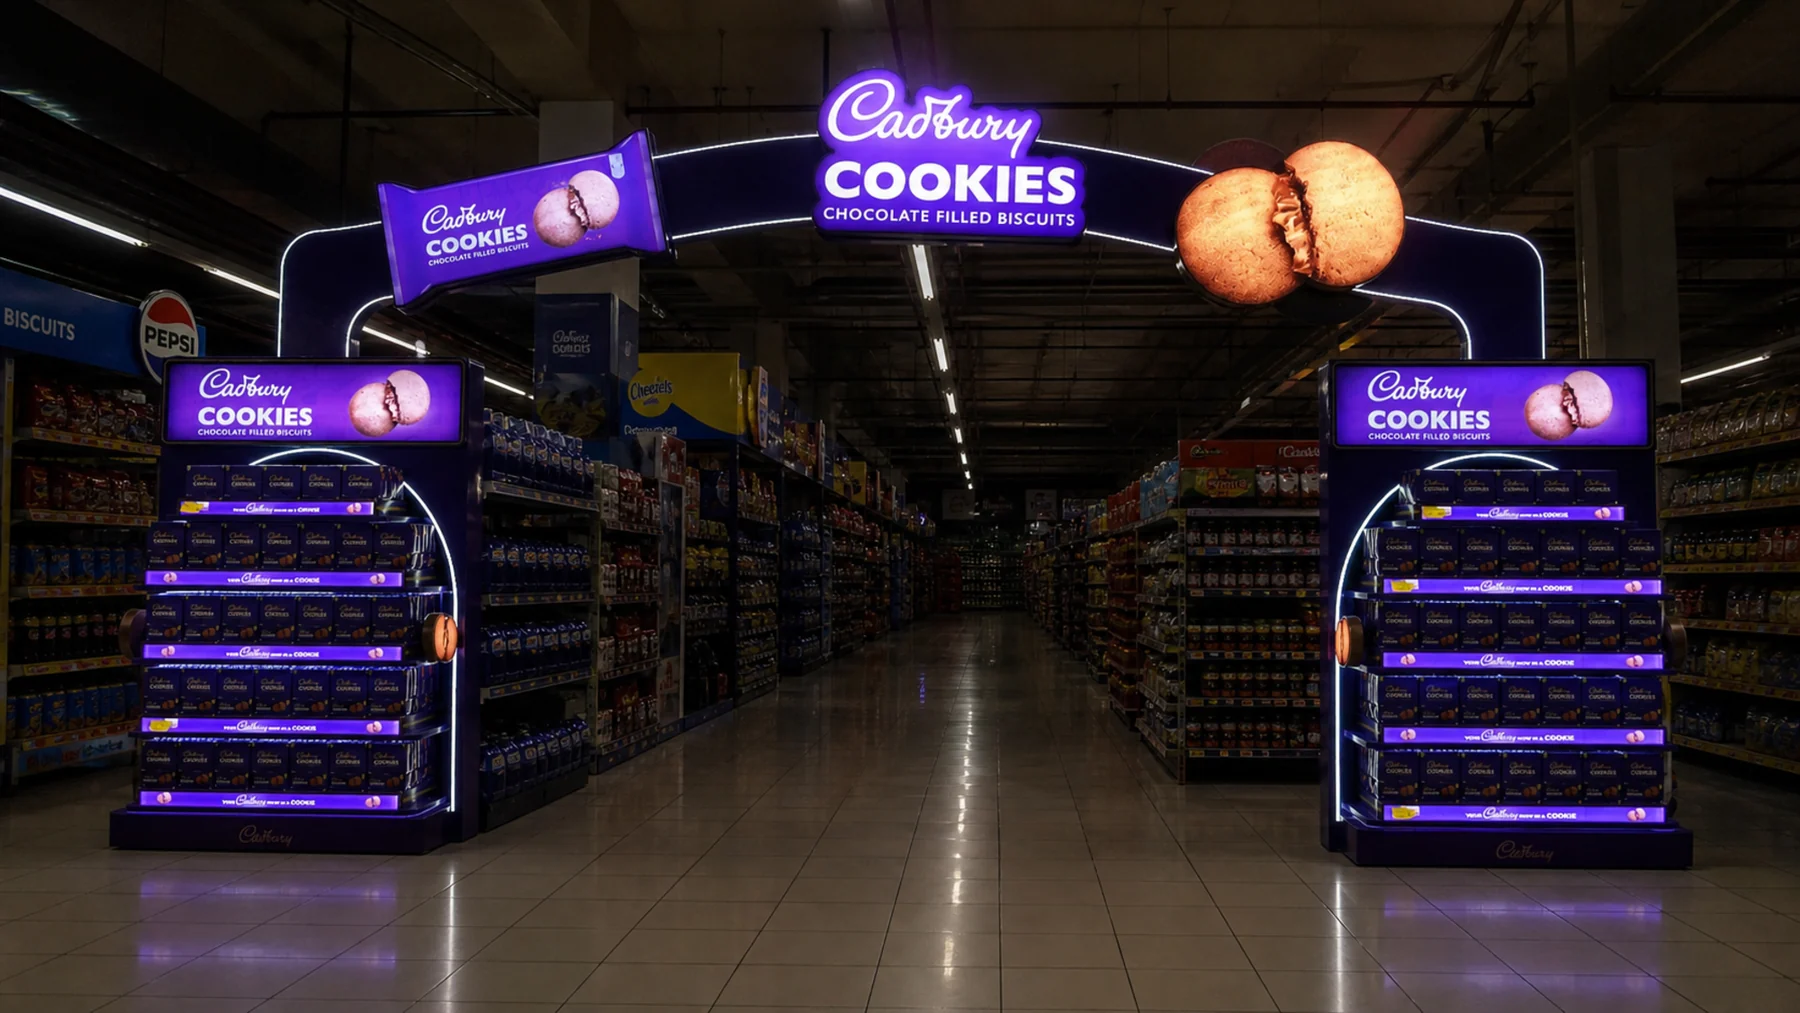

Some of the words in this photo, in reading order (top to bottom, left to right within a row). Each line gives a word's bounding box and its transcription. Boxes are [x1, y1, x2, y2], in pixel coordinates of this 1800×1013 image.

[827, 79, 1032, 158] Cadbury
[824, 161, 1076, 204] COOKIES
[421, 204, 506, 234] Cadbury
[823, 207, 929, 222] CHOCOLATE
[936, 211, 991, 224] FILLED
[998, 213, 1075, 226] BISCUITS
[426, 224, 528, 256] COOKIES
[428, 252, 471, 266] CHOCOLATE
[473, 248, 495, 257] FILLED
[498, 243, 529, 253] BISCUITS
[4, 307, 76, 341] BISCUITS
[145, 326, 194, 354] PEPSI
[198, 368, 292, 404] Cadbury
[1368, 370, 1467, 407] Cadbury
[197, 407, 312, 426] COOKIES
[1368, 410, 1490, 430] COOKIES
[198, 428, 246, 436] CHOCOLATE
